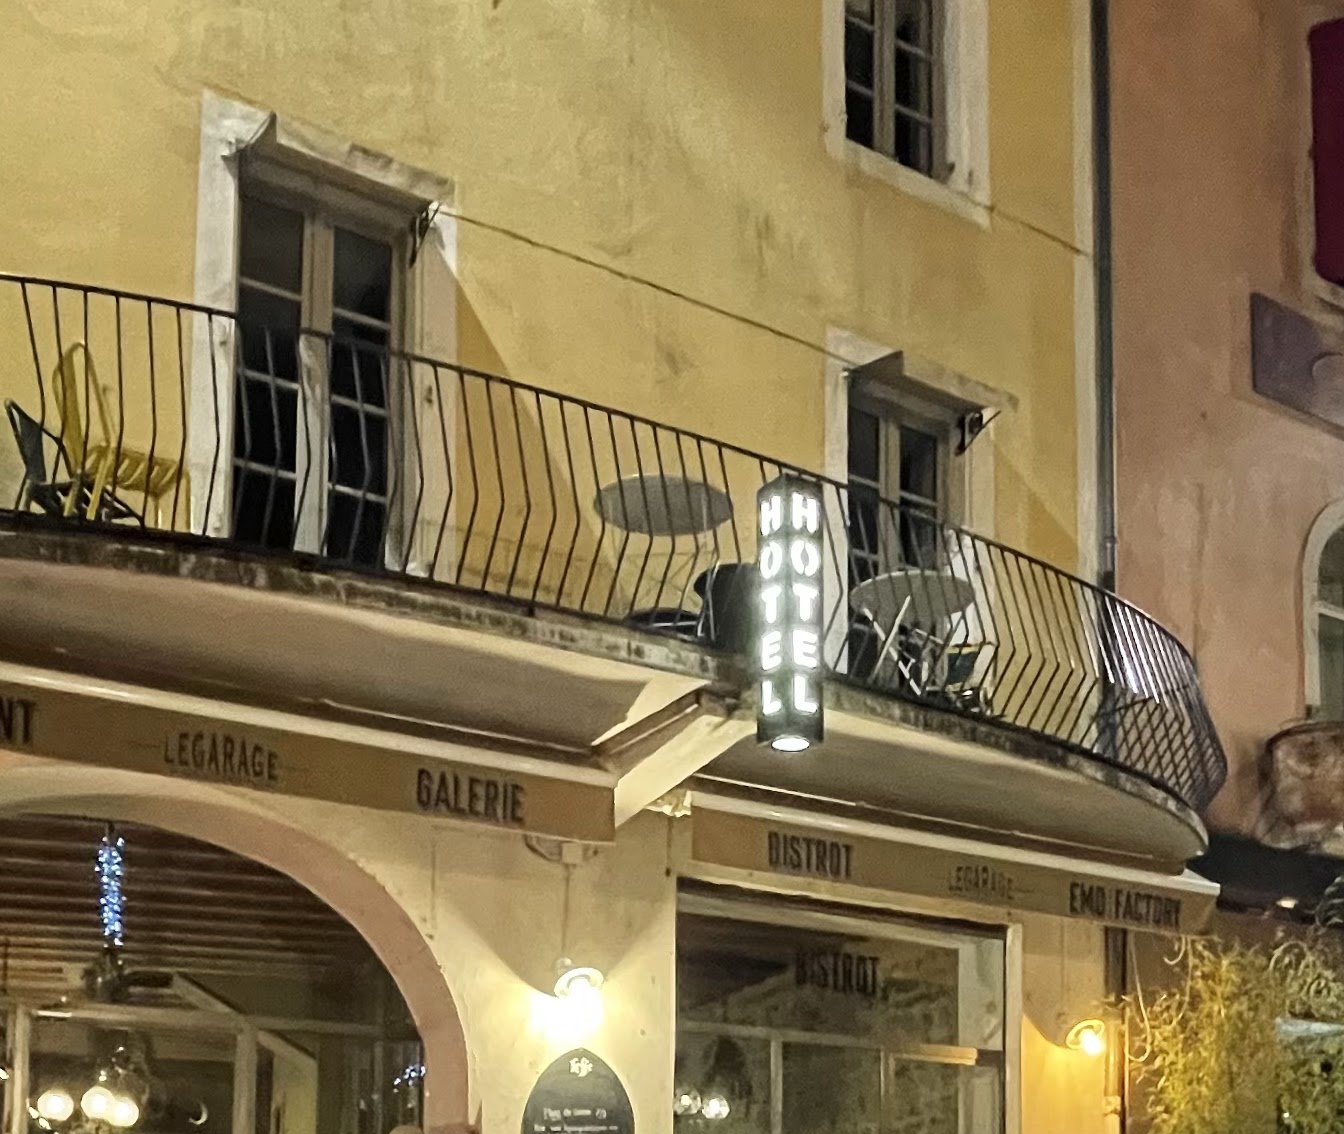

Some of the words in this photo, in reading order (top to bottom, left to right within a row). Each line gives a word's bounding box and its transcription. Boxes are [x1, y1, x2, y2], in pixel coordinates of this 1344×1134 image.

[760, 495, 783, 716] HOTEL
[790, 491, 820, 715] HOTEL
[162, 731, 278, 781] LEGARAGE
[415, 767, 525, 825] GALERIE
[767, 830, 854, 880] BISTROT
[946, 865, 1015, 901] LEGARAGE
[1113, 887, 1183, 929] FACTORY
[794, 951, 880, 997] BISTROT
